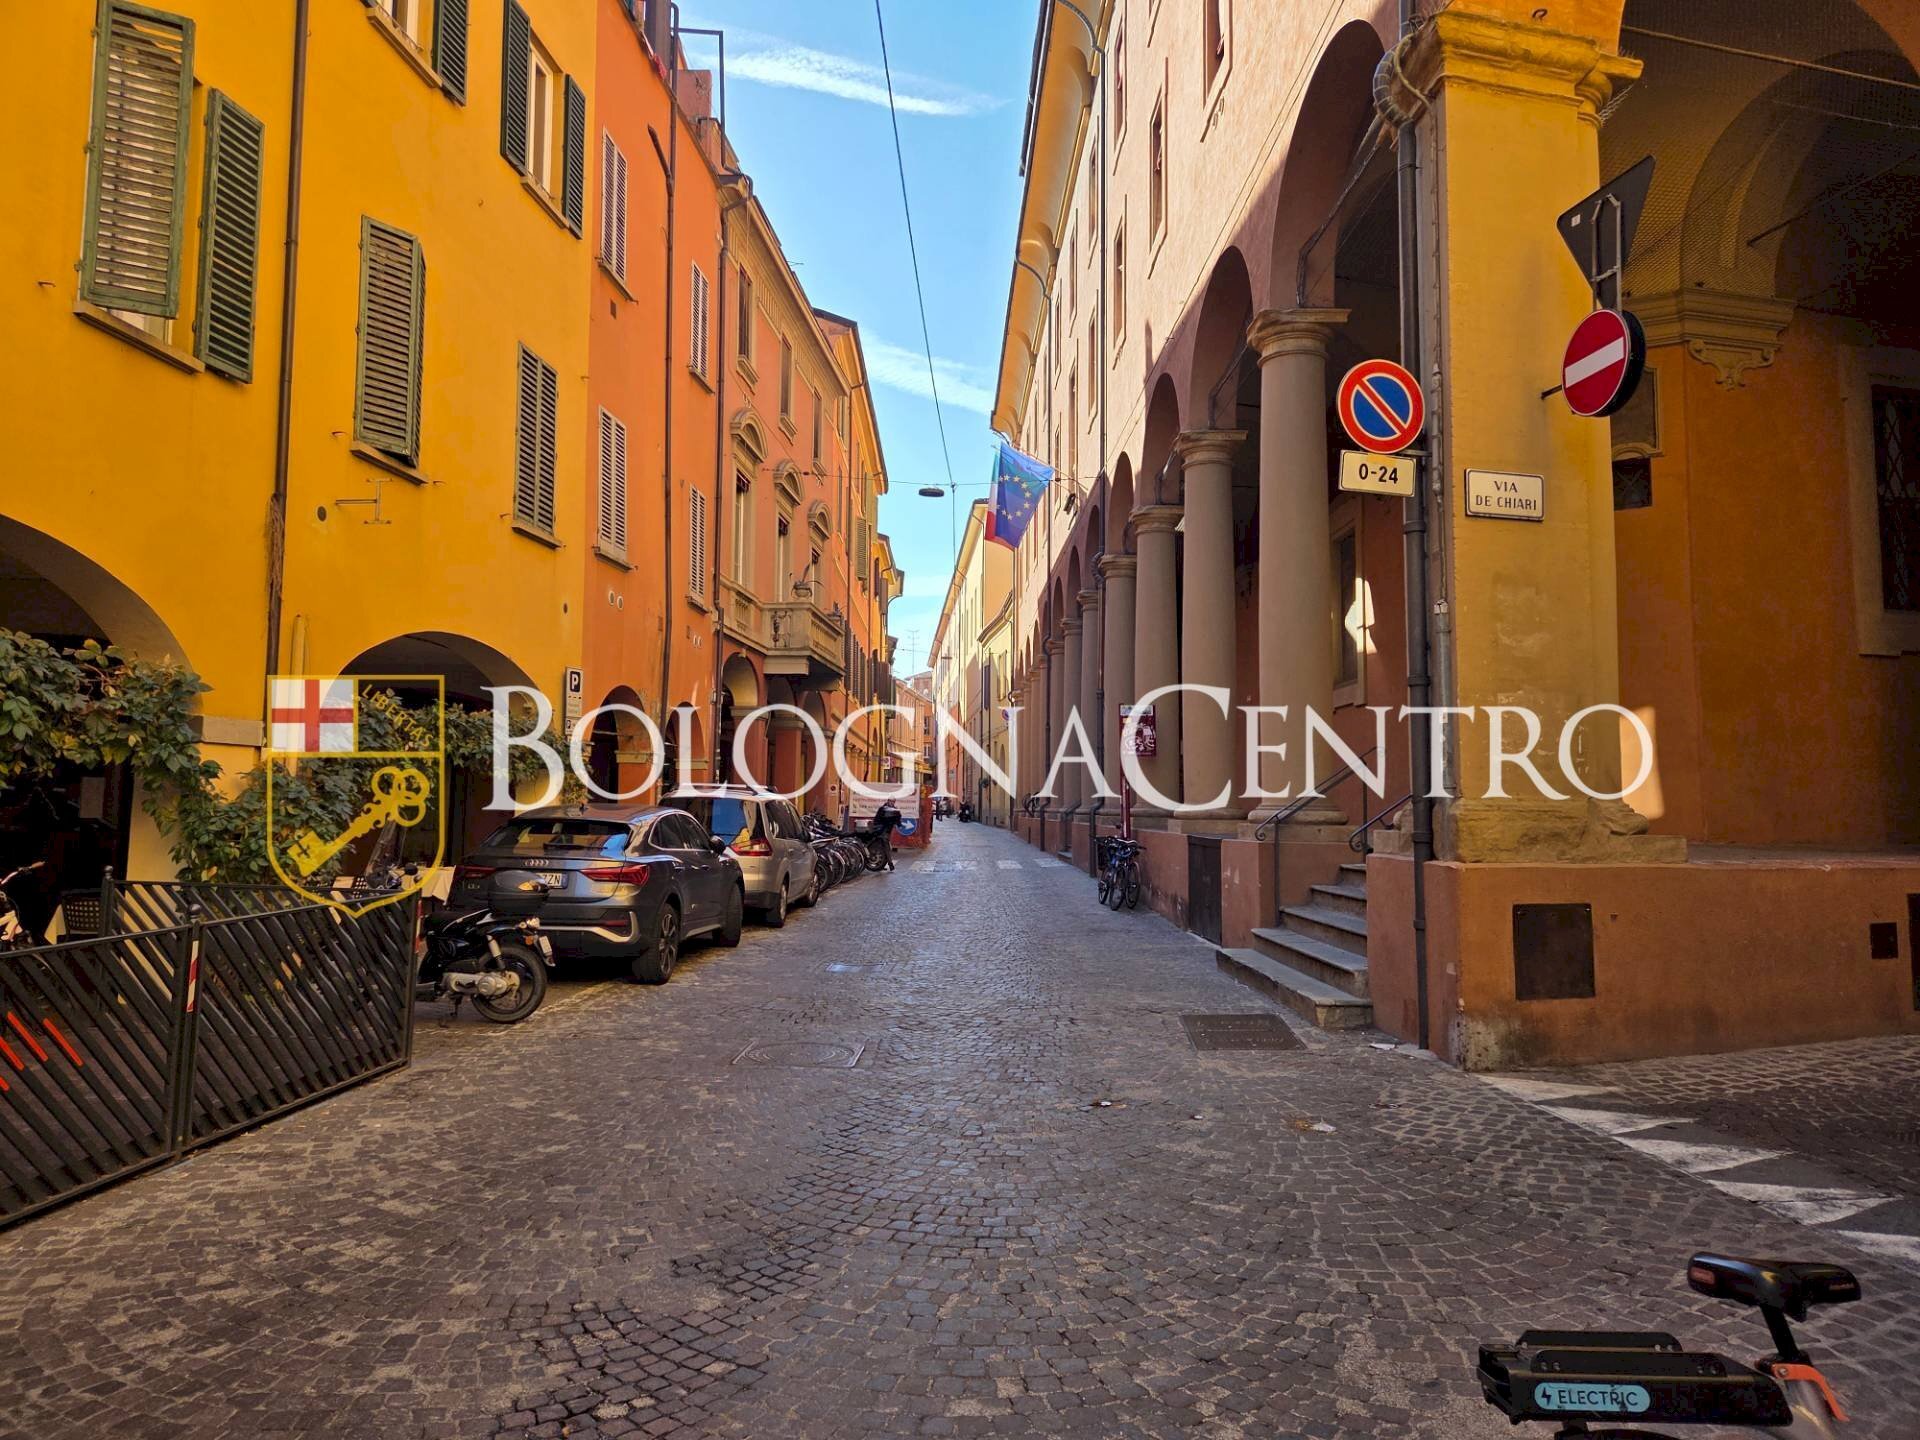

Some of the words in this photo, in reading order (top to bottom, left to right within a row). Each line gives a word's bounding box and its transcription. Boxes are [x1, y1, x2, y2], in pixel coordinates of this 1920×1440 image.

[1359, 463, 1399, 484] 0-24
[1493, 480, 1518, 493] VIA
[1497, 496, 1537, 511] CHIARI
[1557, 1389, 1638, 1407] ELECTRIC
